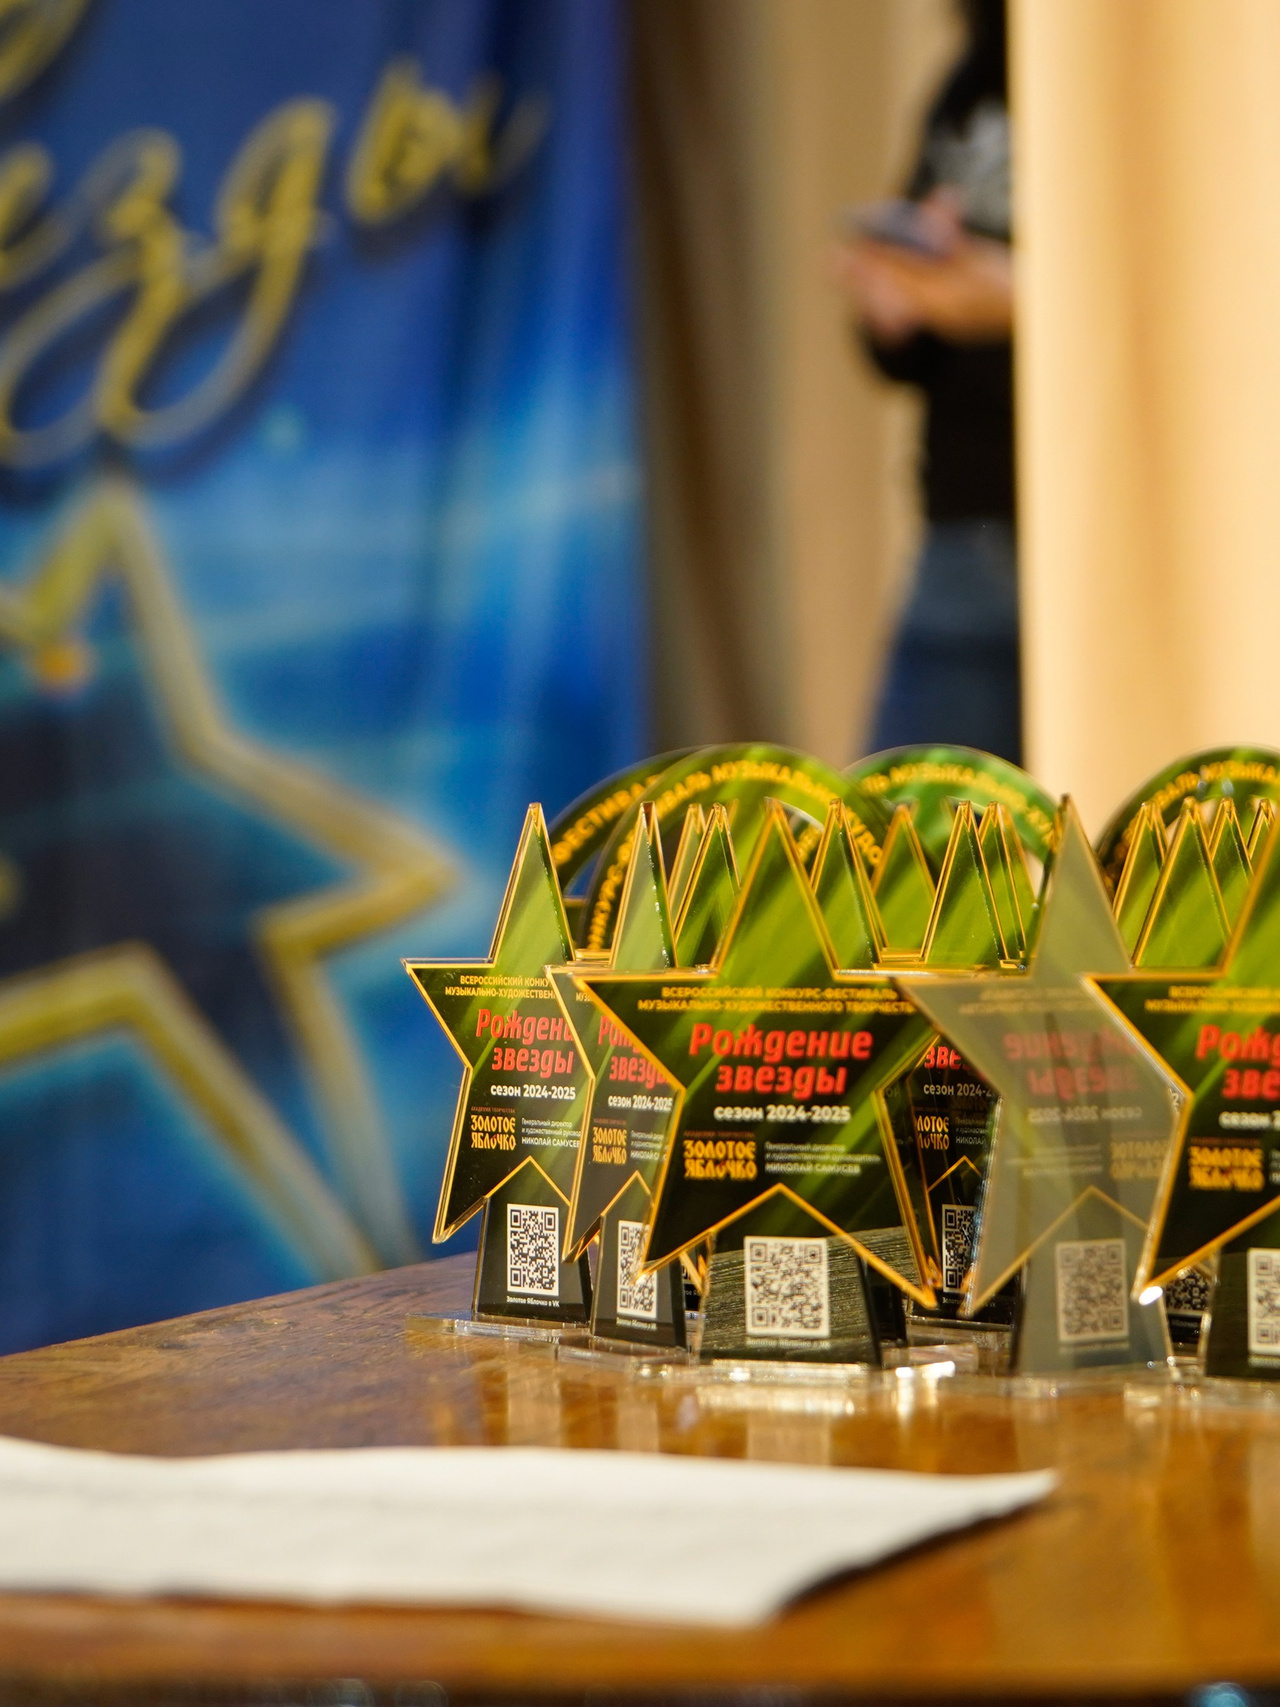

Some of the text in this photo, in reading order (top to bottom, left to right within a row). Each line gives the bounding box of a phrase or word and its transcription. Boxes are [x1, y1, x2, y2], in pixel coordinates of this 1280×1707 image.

[460, 975, 523, 986] ВСЕРОССИЙСКИЙ
[688, 1022, 874, 1064] Рождение
[492, 1047, 574, 1078] звезды
[715, 1064, 847, 1100] звезды
[923, 1083, 954, 1096] сезон
[490, 1084, 576, 1100] сезон 2024-2025
[608, 1095, 632, 1108] сезон
[713, 1104, 851, 1123] сезон 2024-2025
[470, 1114, 516, 1133] ЗОЛОТОЕ
[471, 1132, 516, 1151] ЯБЛОЧКО
[521, 1137, 551, 1146] НИКОЛАЙ
[683, 1139, 756, 1160] ЗОЛОТОЕ
